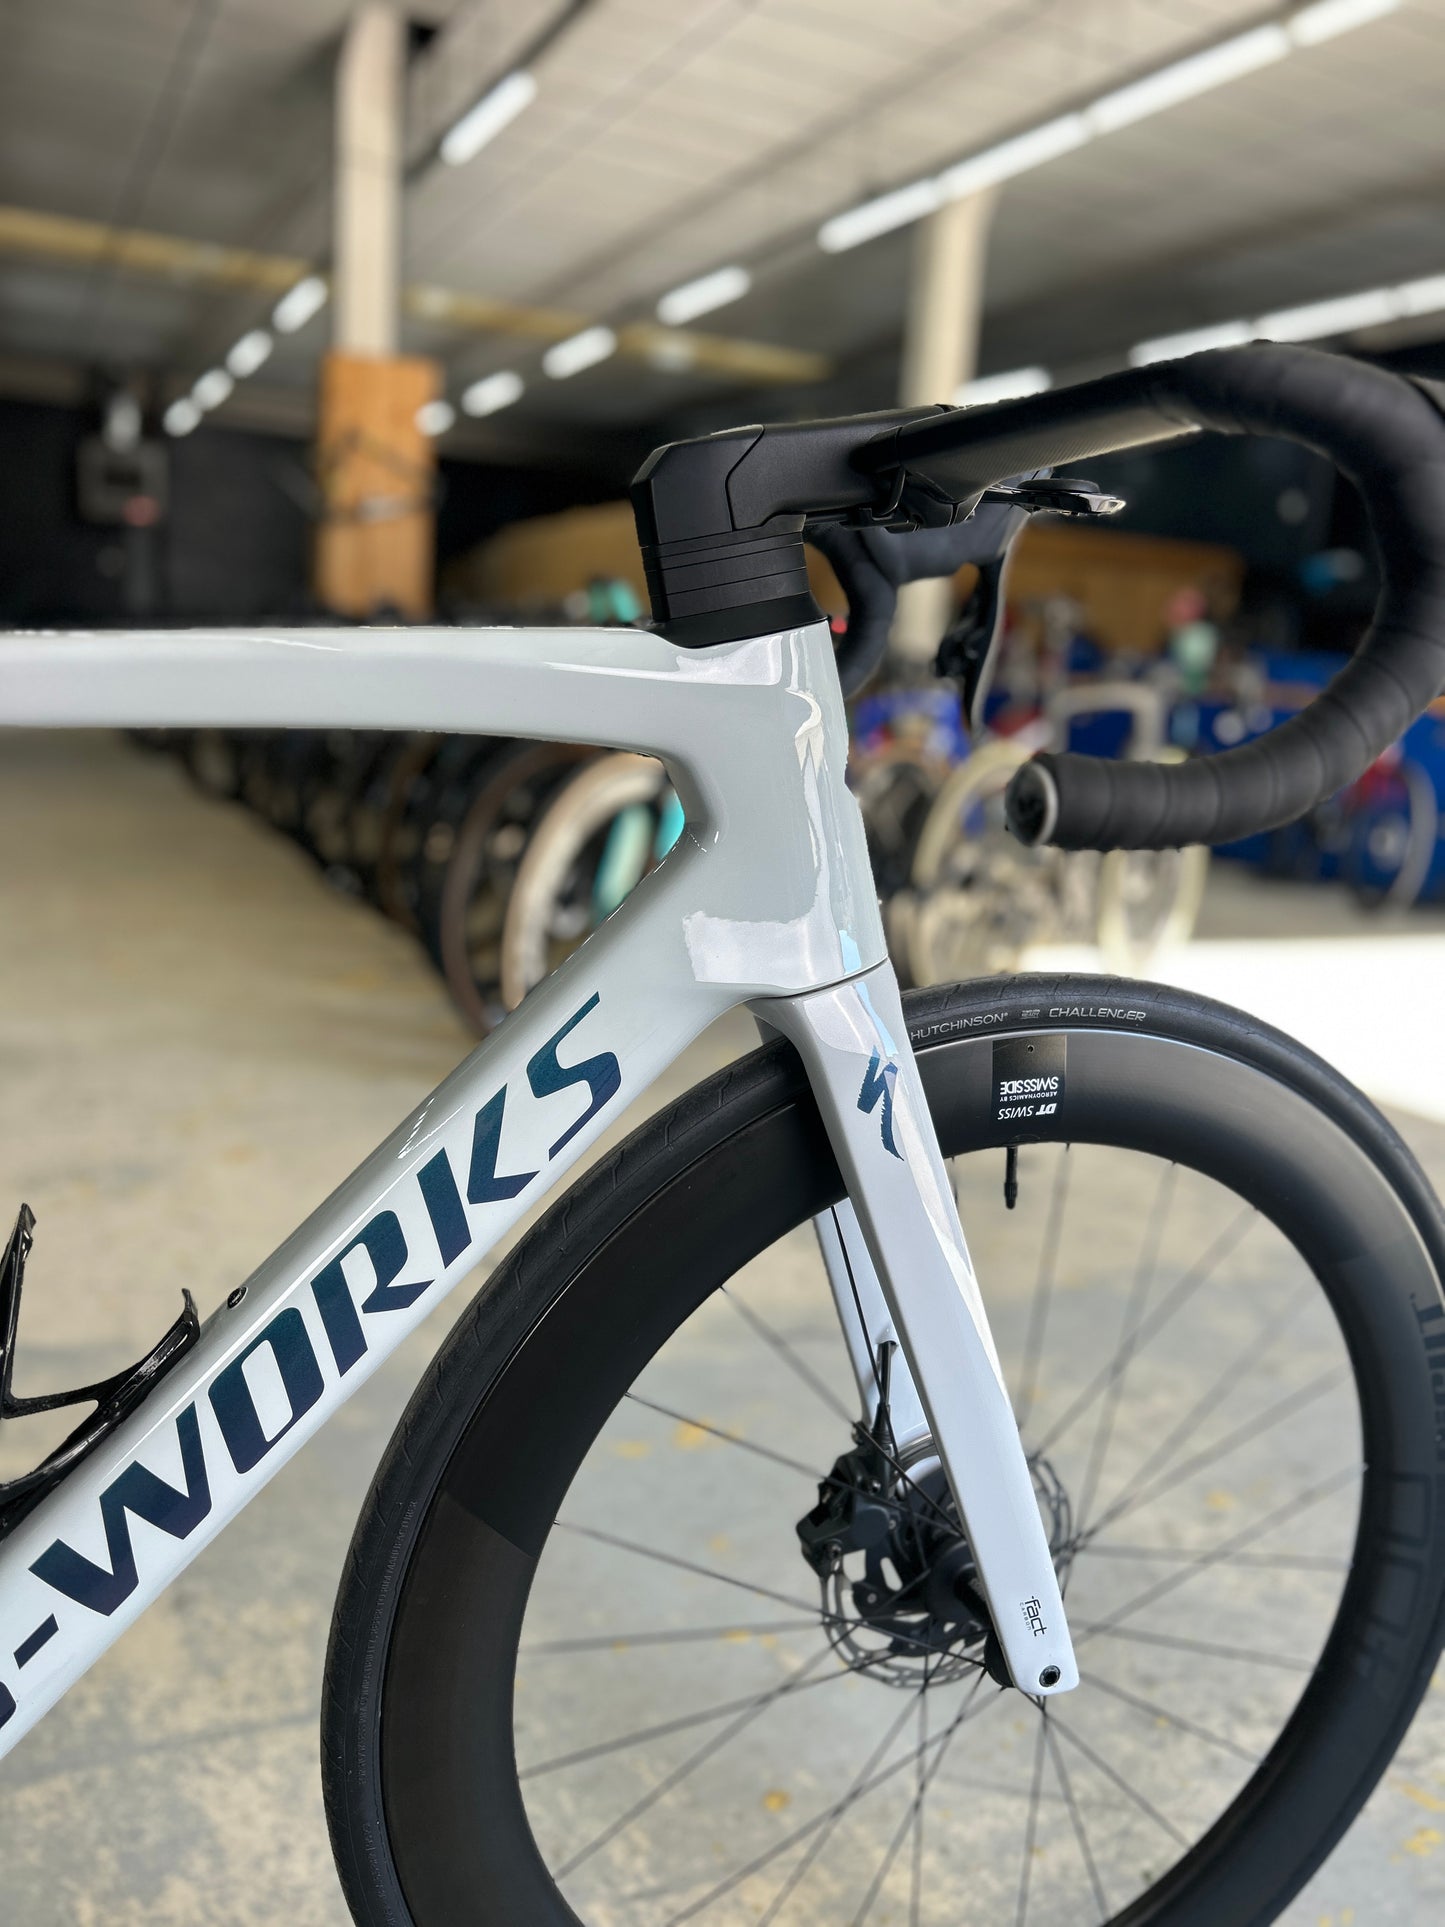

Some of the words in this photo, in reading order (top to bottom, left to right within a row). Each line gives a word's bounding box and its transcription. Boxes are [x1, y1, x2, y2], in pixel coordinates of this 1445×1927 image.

[1049, 1007, 1146, 1022] CHALLENGER
[1009, 1091, 1058, 1102] AERODYNAMICS
[998, 1105, 1034, 1120] SWISS
[1036, 1103, 1057, 1116] DT
[0, 991, 622, 1729] -WORKS
